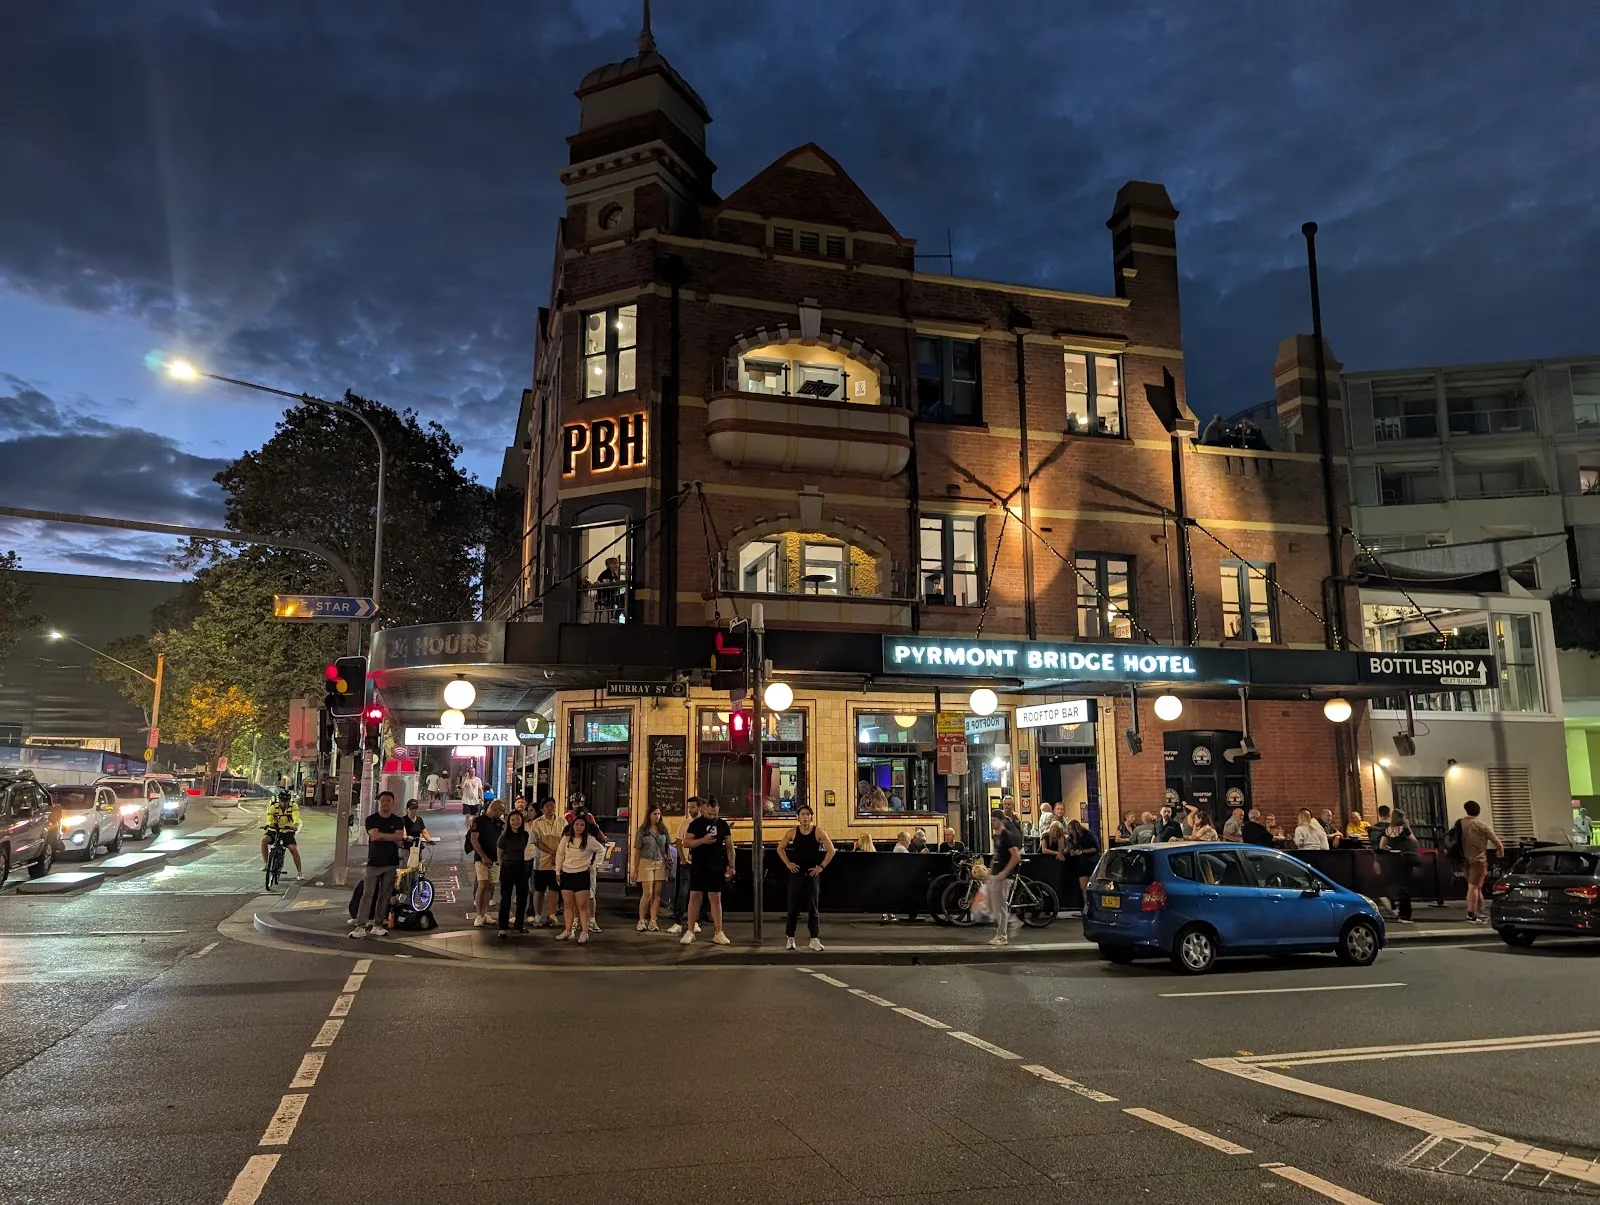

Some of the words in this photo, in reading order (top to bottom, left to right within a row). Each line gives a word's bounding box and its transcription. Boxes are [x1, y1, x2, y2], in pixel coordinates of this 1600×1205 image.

[562, 411, 646, 476] PBH
[316, 602, 350, 611] STAR
[414, 634, 492, 656] HOURS
[894, 645, 1018, 667] PYRMONT
[1027, 650, 1115, 671] BRIDGE
[1123, 654, 1197, 674] HOTEL
[1369, 658, 1475, 676] BOTTLESHOP
[610, 684, 650, 693] MURRAY
[656, 685, 668, 694] ST
[1023, 709, 1059, 723] ROOFTOP
[1062, 706, 1079, 719] BAR
[417, 732, 479, 741] ROOFTOP
[483, 733, 509, 742] BAR
